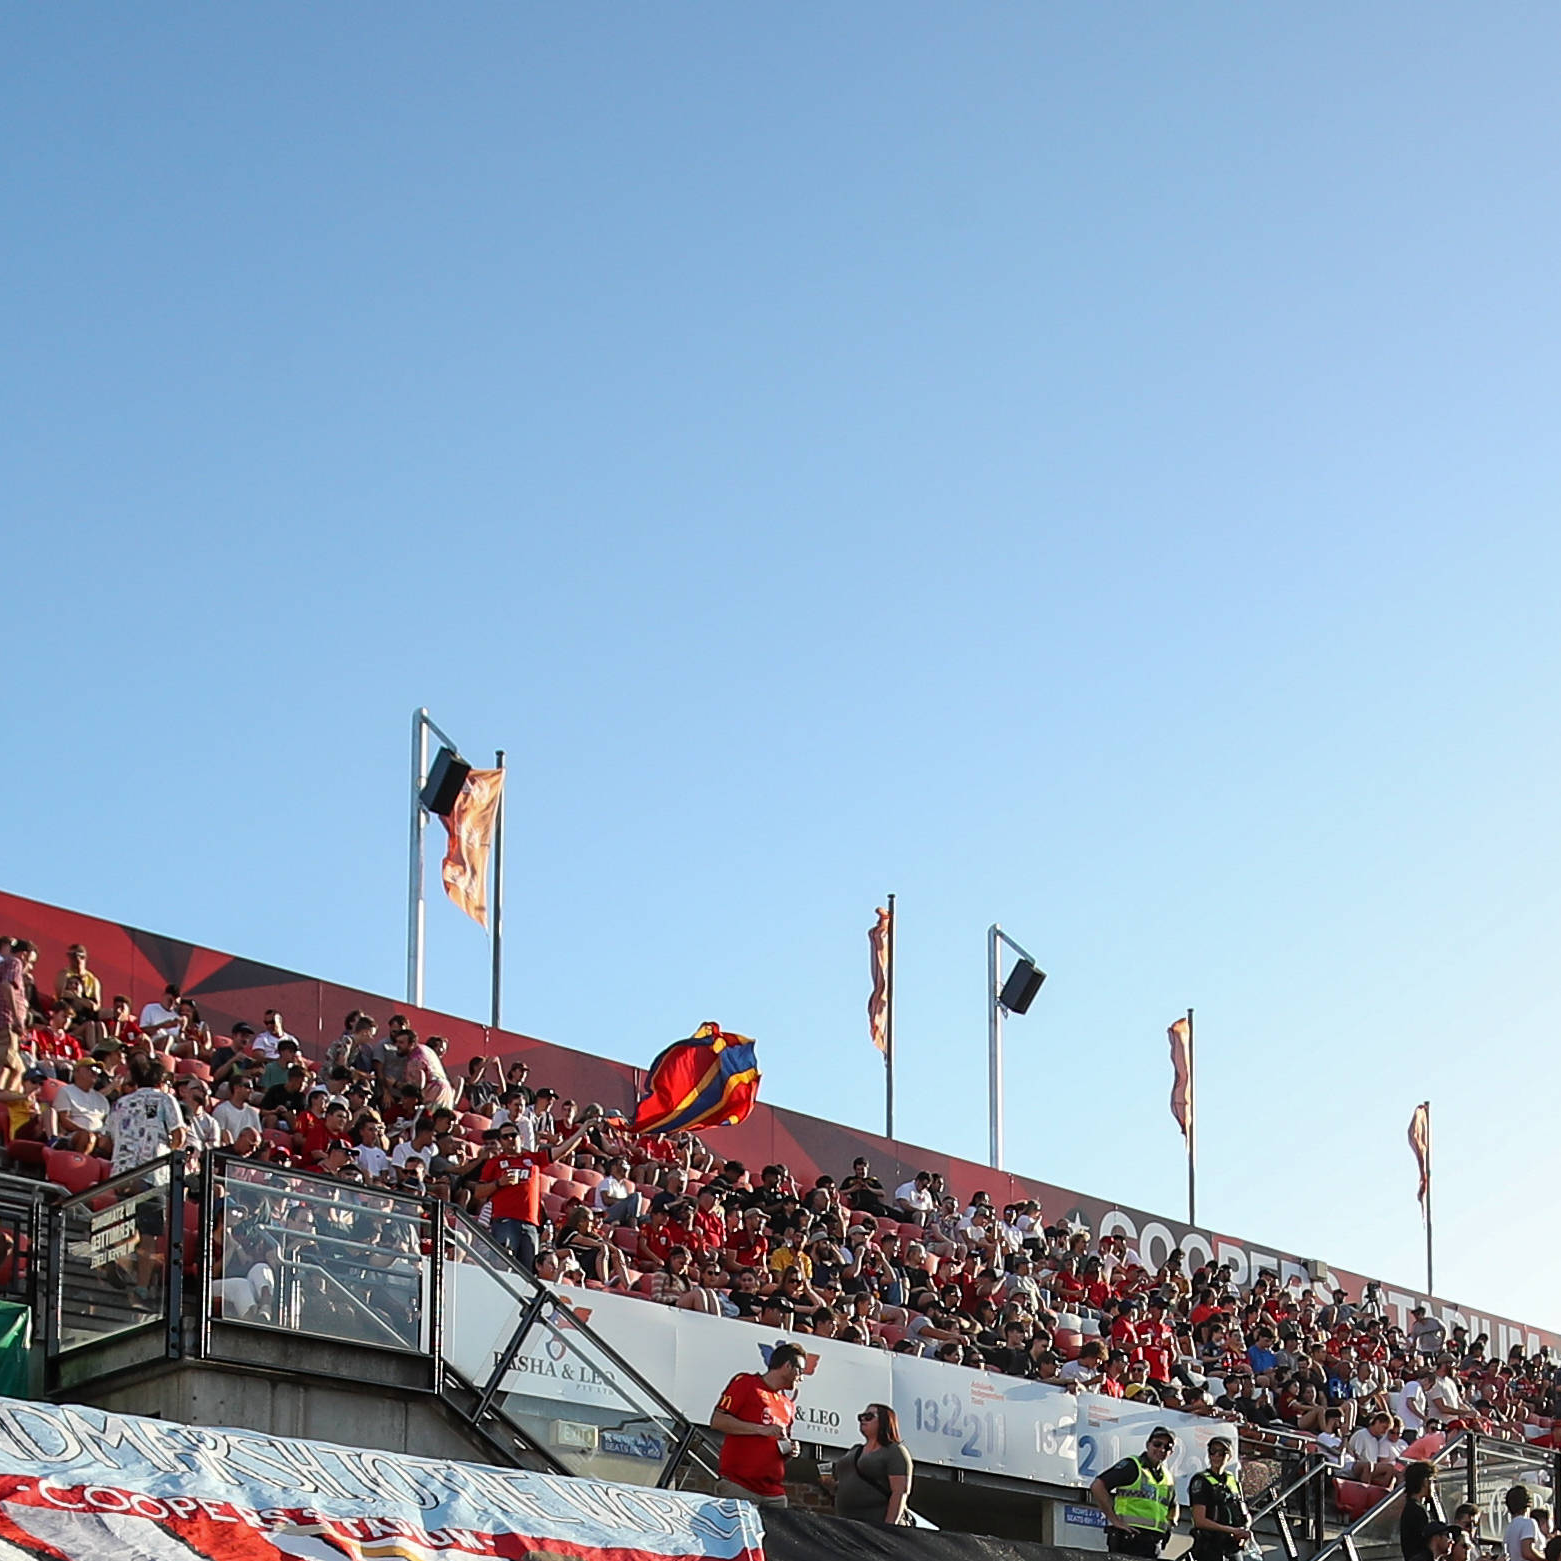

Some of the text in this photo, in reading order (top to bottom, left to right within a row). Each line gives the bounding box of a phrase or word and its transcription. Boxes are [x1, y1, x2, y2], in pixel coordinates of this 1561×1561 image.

[1361, 1284, 1541, 1362] STDIUM
[810, 1408, 840, 1428] LEO
[37, 1479, 291, 1531] COOPERS
[398, 1459, 585, 1523] THE
